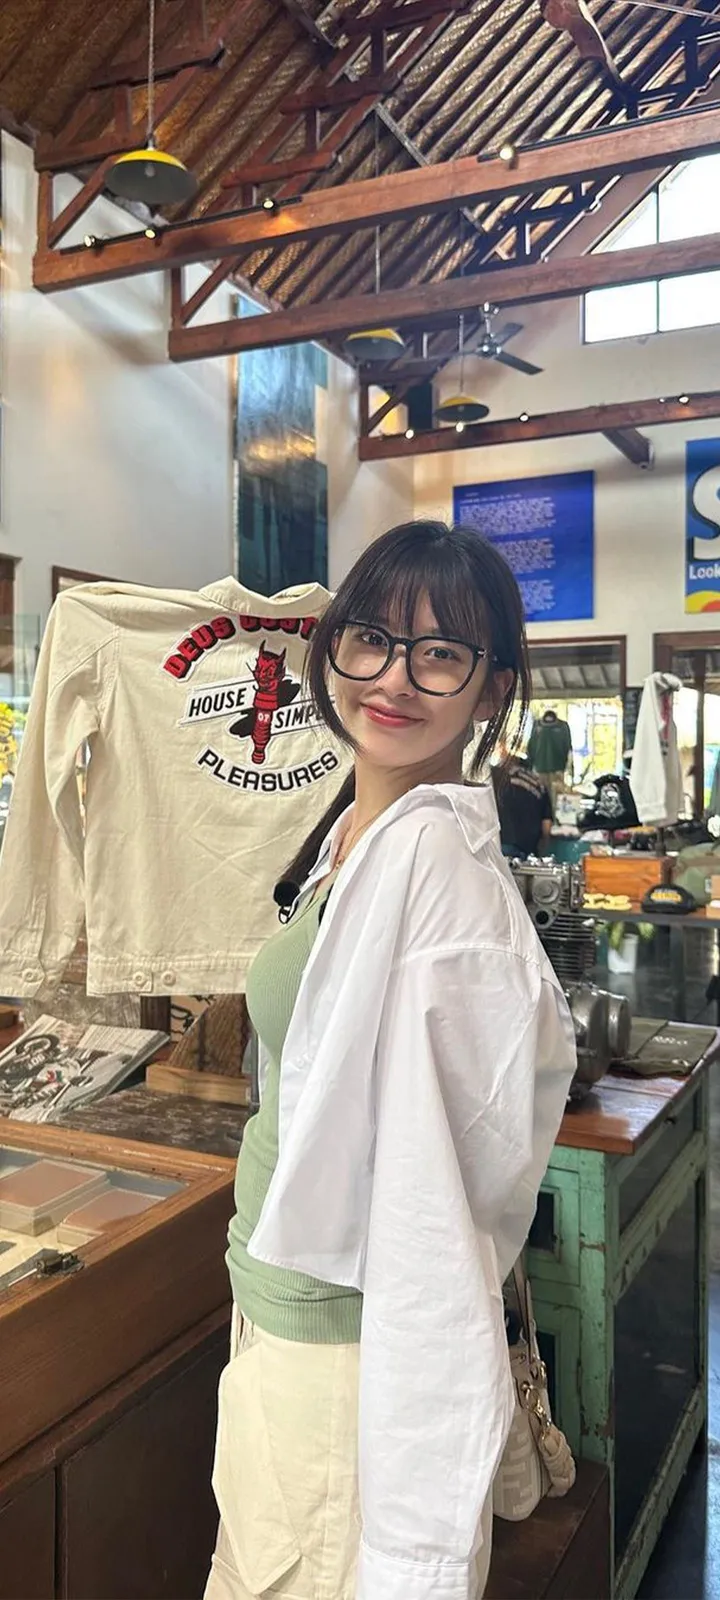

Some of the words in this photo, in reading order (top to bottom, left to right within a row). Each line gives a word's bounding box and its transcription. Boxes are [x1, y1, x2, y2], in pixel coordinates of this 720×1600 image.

[163, 616, 236, 679] DEUS
[189, 688, 247, 717] HOUSE
[274, 703, 323, 729] SIMPL
[198, 750, 338, 791] PLEASURES
